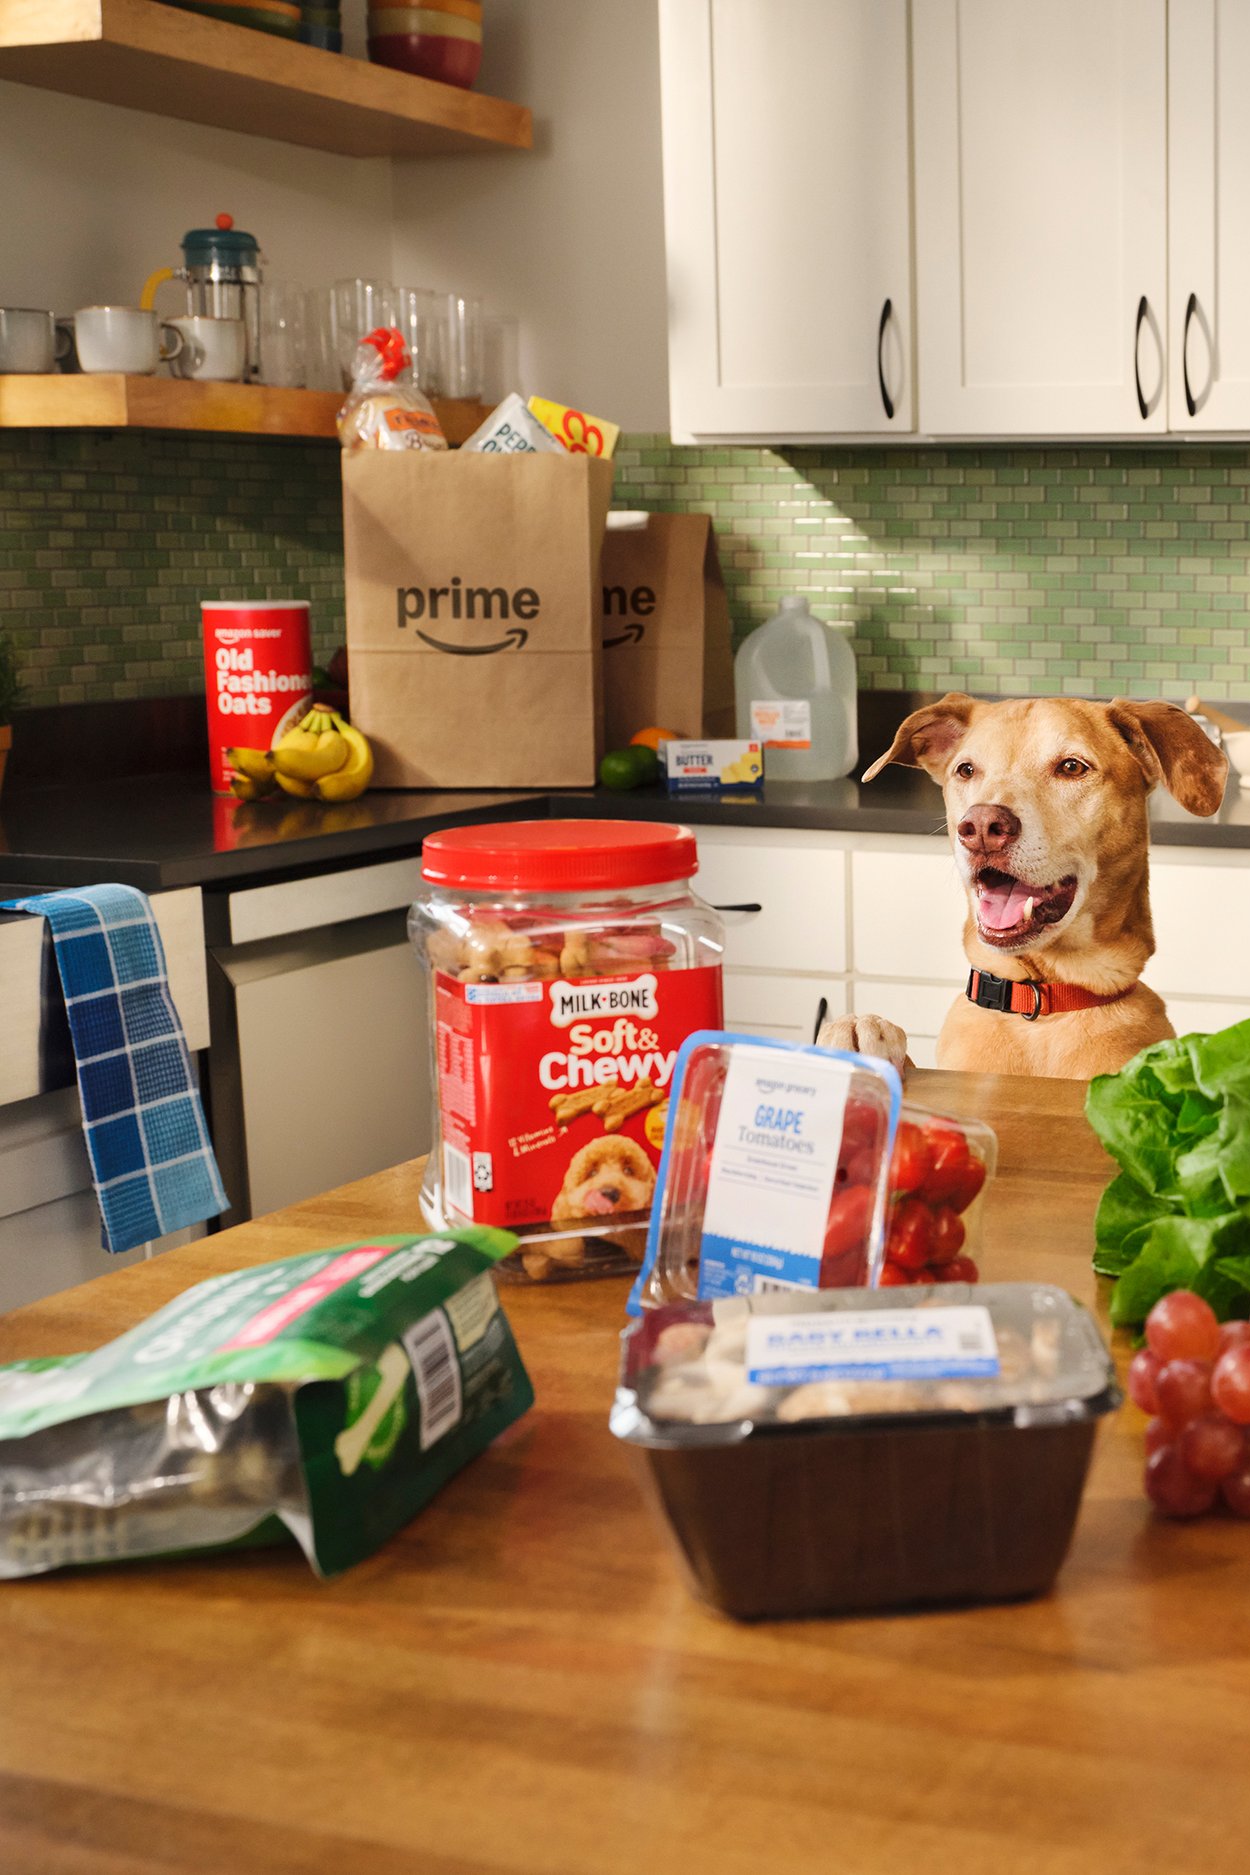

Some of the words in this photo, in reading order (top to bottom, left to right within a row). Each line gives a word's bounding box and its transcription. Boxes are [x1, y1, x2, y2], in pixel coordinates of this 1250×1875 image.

[397, 576, 540, 628] prime
[215, 648, 254, 671] Old
[217, 692, 273, 715] Oats
[676, 754, 713, 766] BUTTER
[539, 1050, 678, 1090] Chewy
[755, 1104, 804, 1134] GRAPE
[738, 1125, 815, 1154] Tomatoes
[853, 1326, 942, 1342] BELLA
